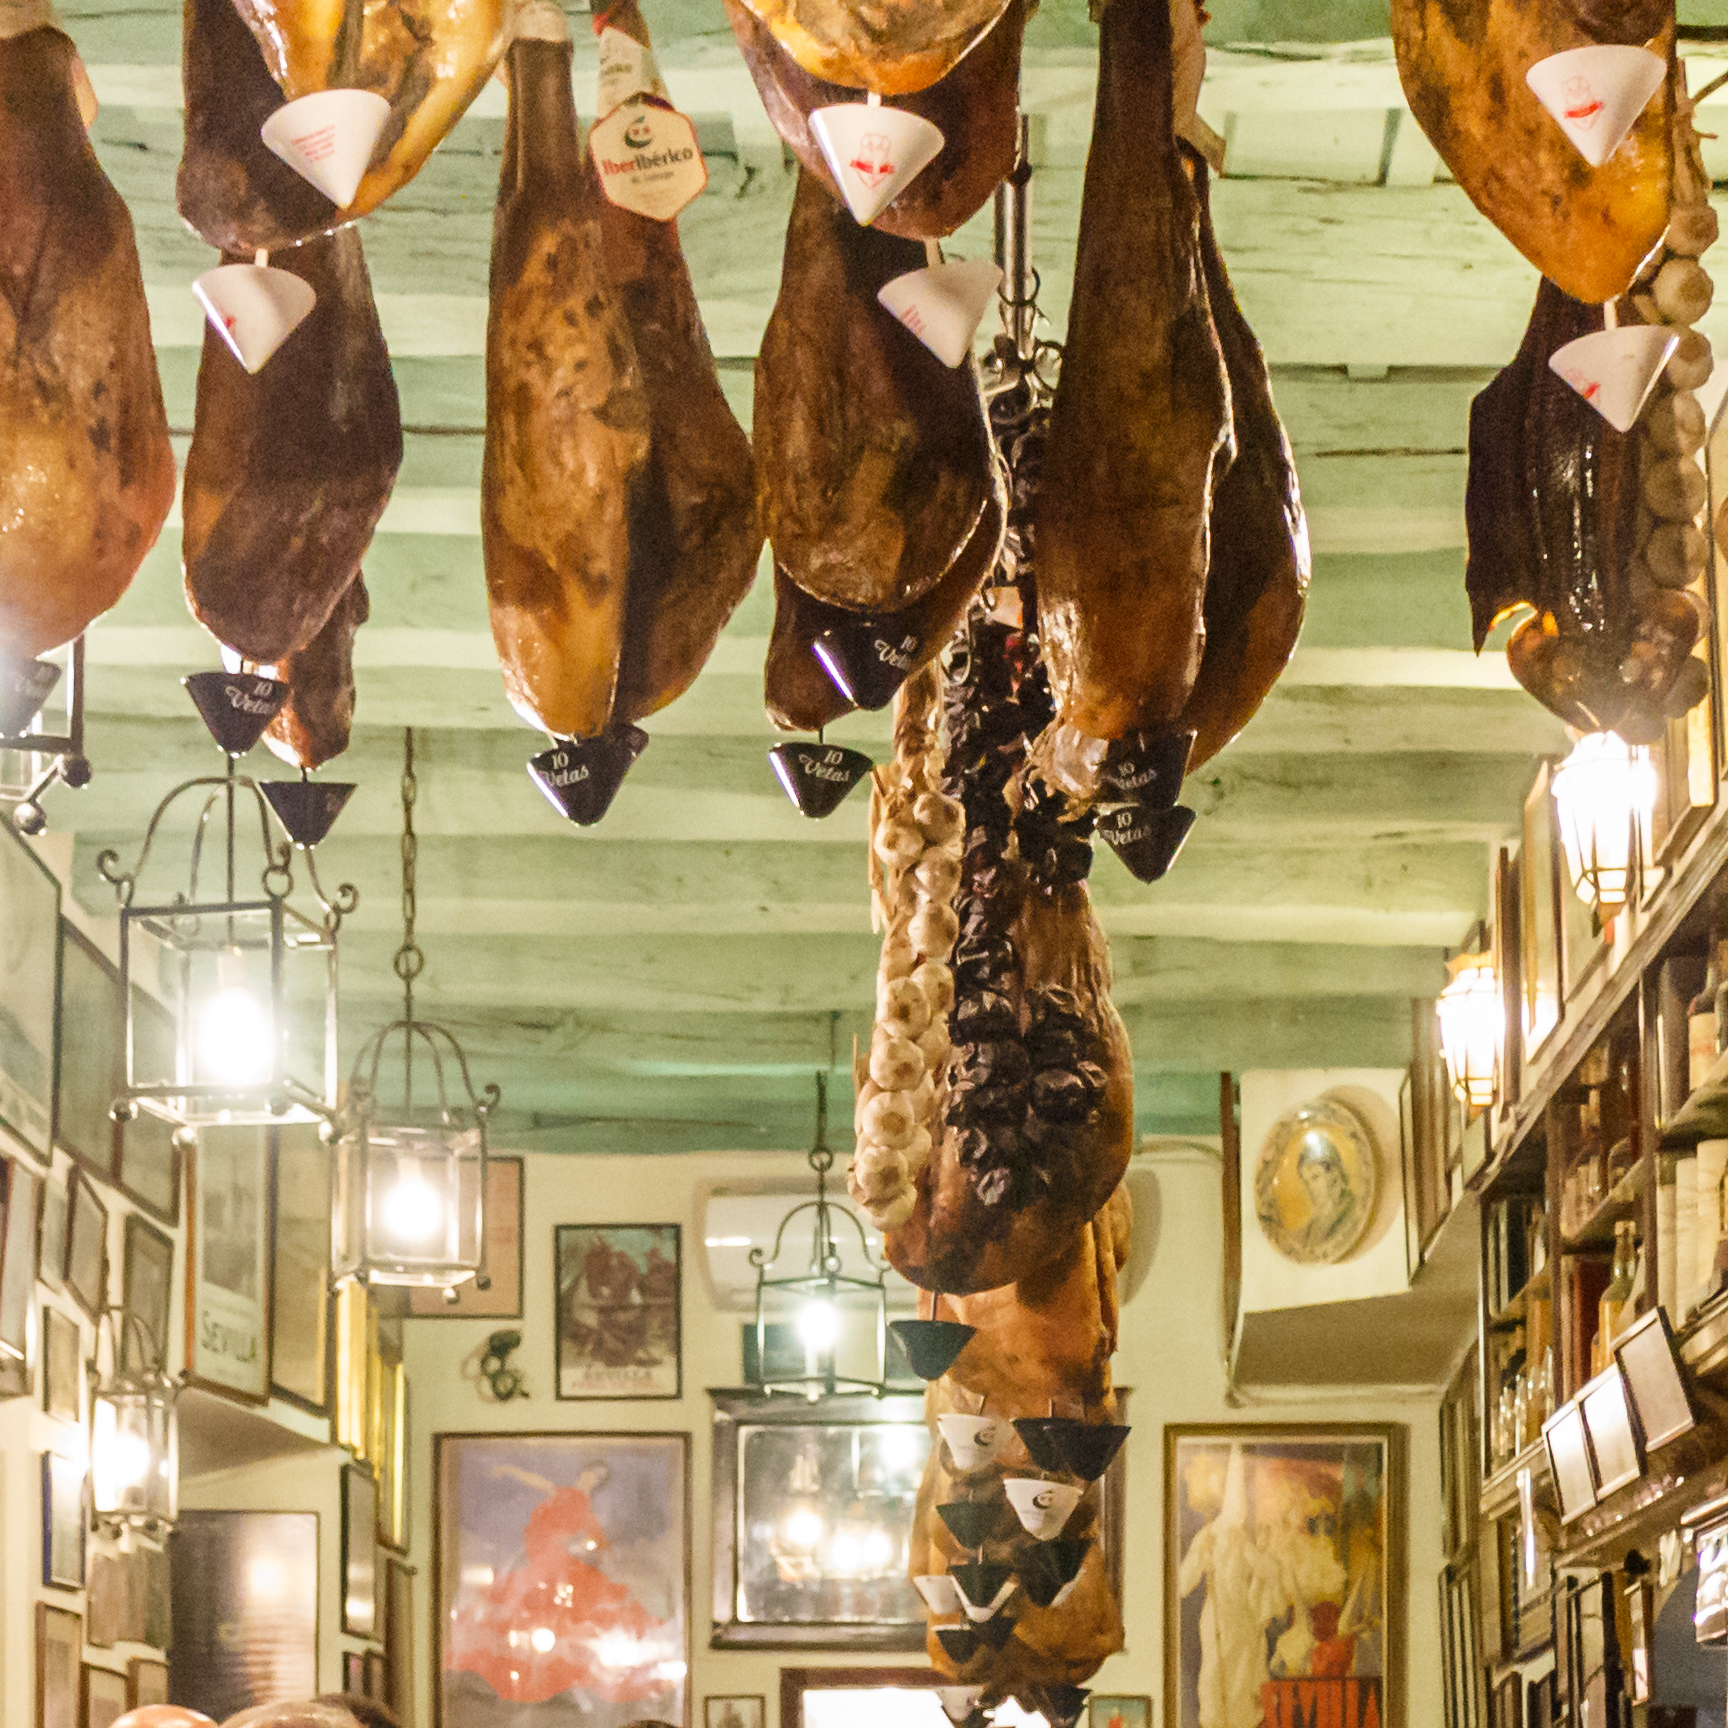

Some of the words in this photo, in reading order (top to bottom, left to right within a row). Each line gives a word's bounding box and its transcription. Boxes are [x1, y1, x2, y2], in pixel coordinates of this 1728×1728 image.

[551, 752, 570, 770] 10
[824, 749, 844, 766] 10
[543, 763, 590, 789] Vetas
[799, 754, 851, 783] Vetas
[1117, 762, 1136, 779] 10
[1115, 812, 1133, 829] 10
[1104, 823, 1153, 847] Vetas
